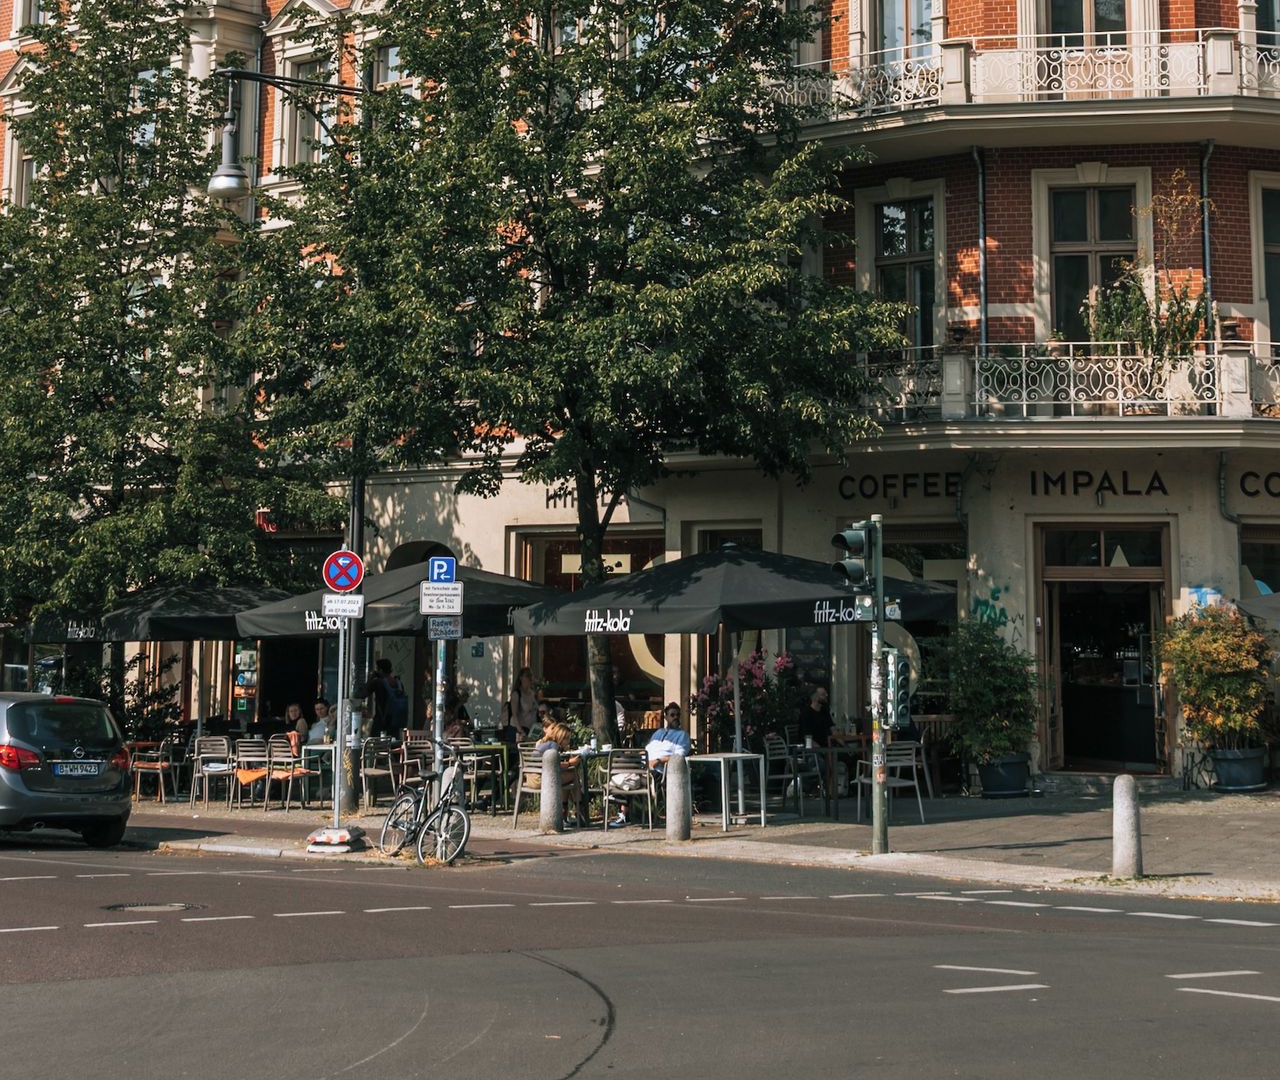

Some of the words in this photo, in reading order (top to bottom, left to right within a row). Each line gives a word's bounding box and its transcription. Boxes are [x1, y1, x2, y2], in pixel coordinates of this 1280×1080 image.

[839, 473, 962, 500] COFFEE
[1030, 470, 1169, 497] IMPALA
[433, 560, 448, 580] P
[584, 609, 631, 632] fritz-kola
